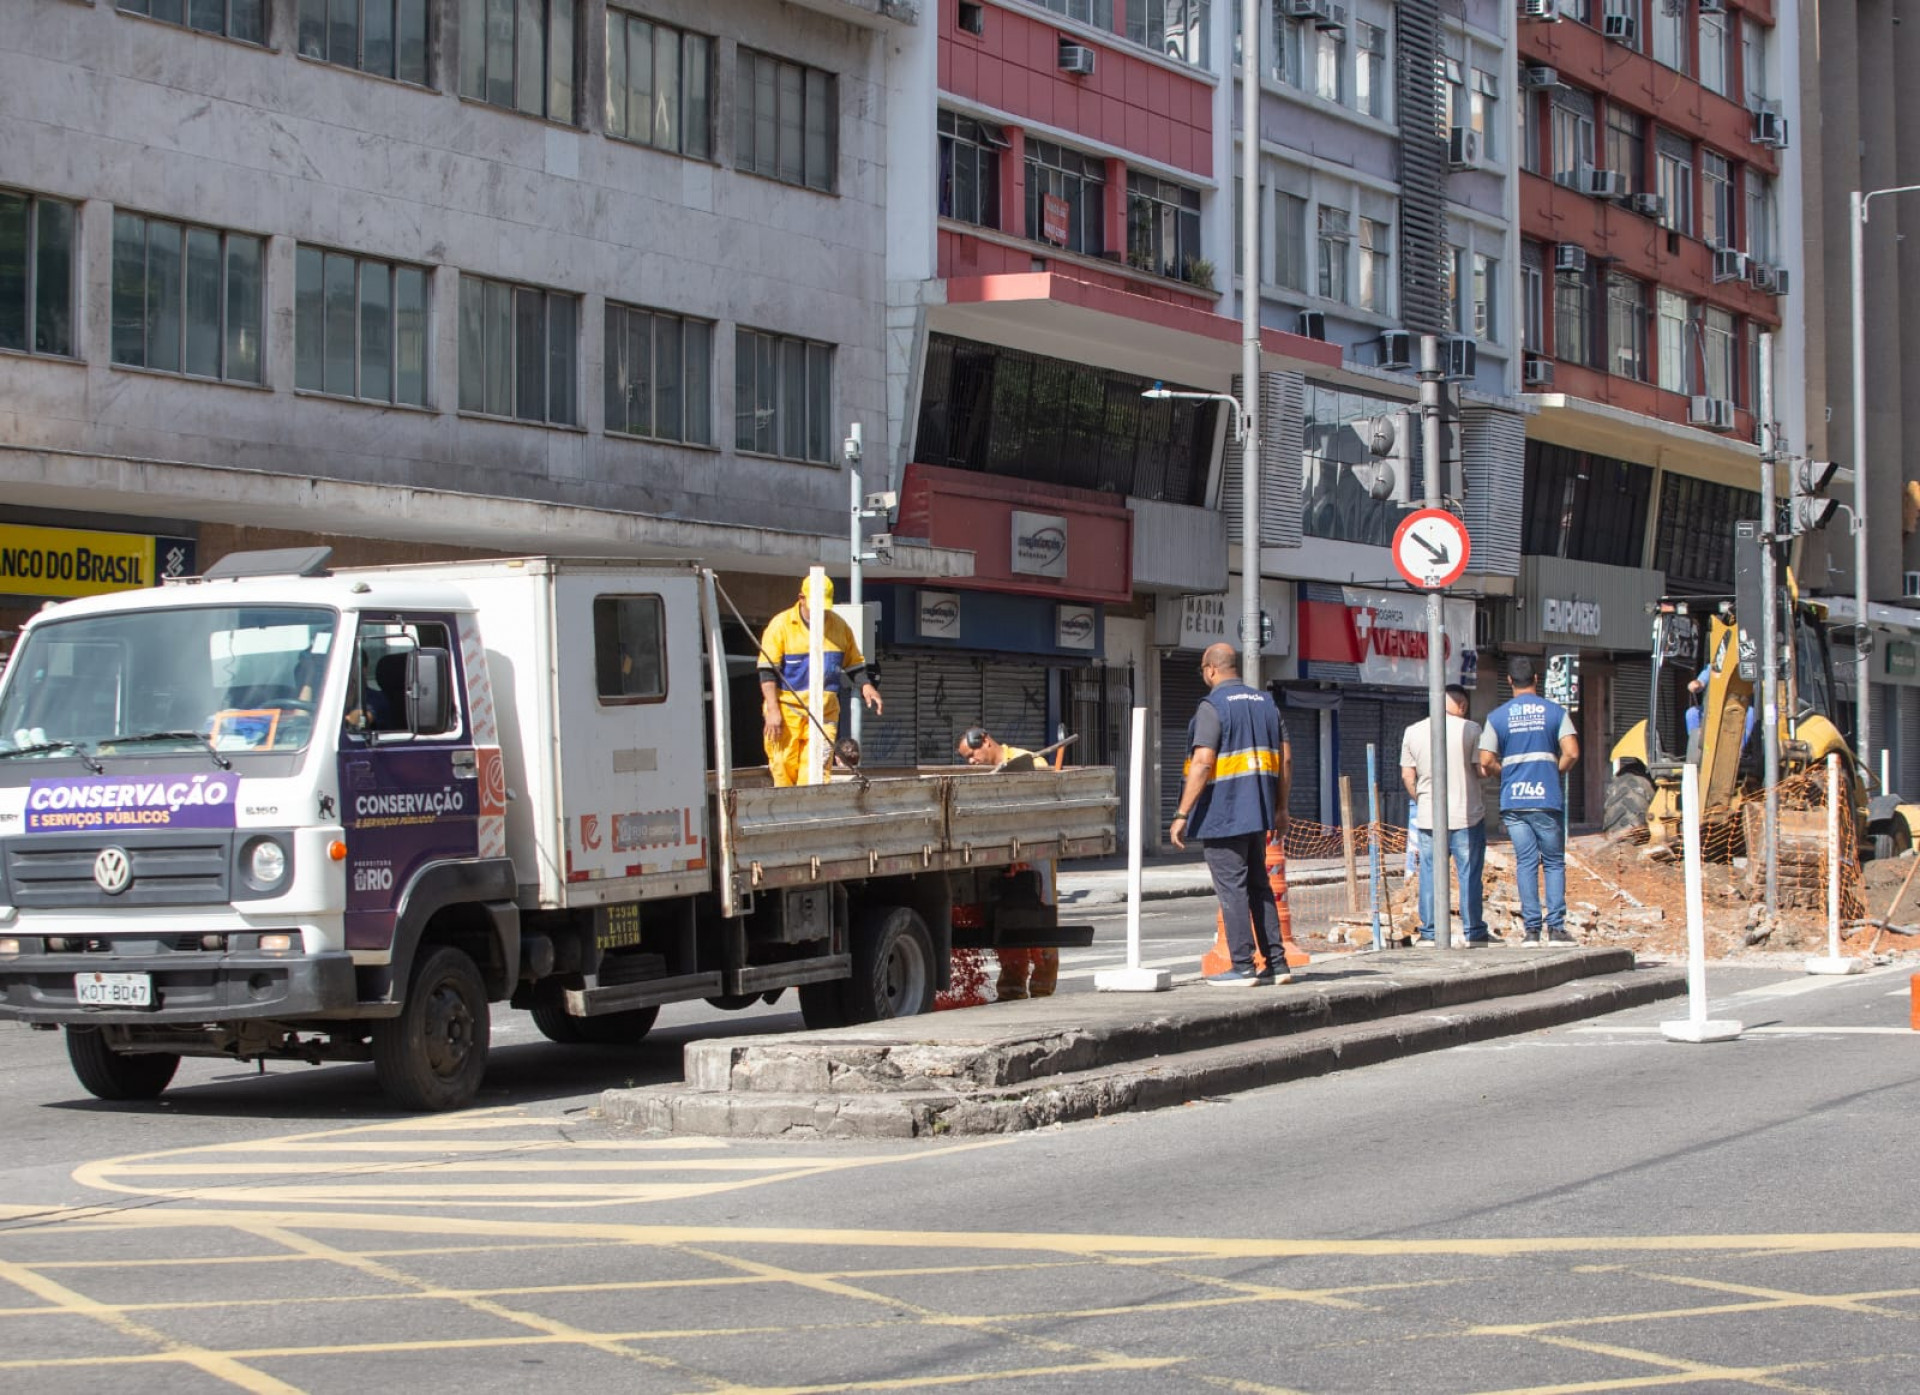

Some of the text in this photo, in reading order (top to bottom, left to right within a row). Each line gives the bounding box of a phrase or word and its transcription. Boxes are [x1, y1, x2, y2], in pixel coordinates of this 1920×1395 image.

[0, 547, 143, 585] NCO DO BRASIL
[1187, 597, 1225, 616] MARIA
[1186, 613, 1225, 634] CÉLIA
[30, 775, 229, 812] CONSERVAÇÃO
[1511, 781, 1546, 796] 1746
[355, 786, 464, 815] CONSERVAÇÃO
[30, 807, 170, 829] E SERVIÇOS PÚBLICOS
[367, 868, 393, 891] RIO
